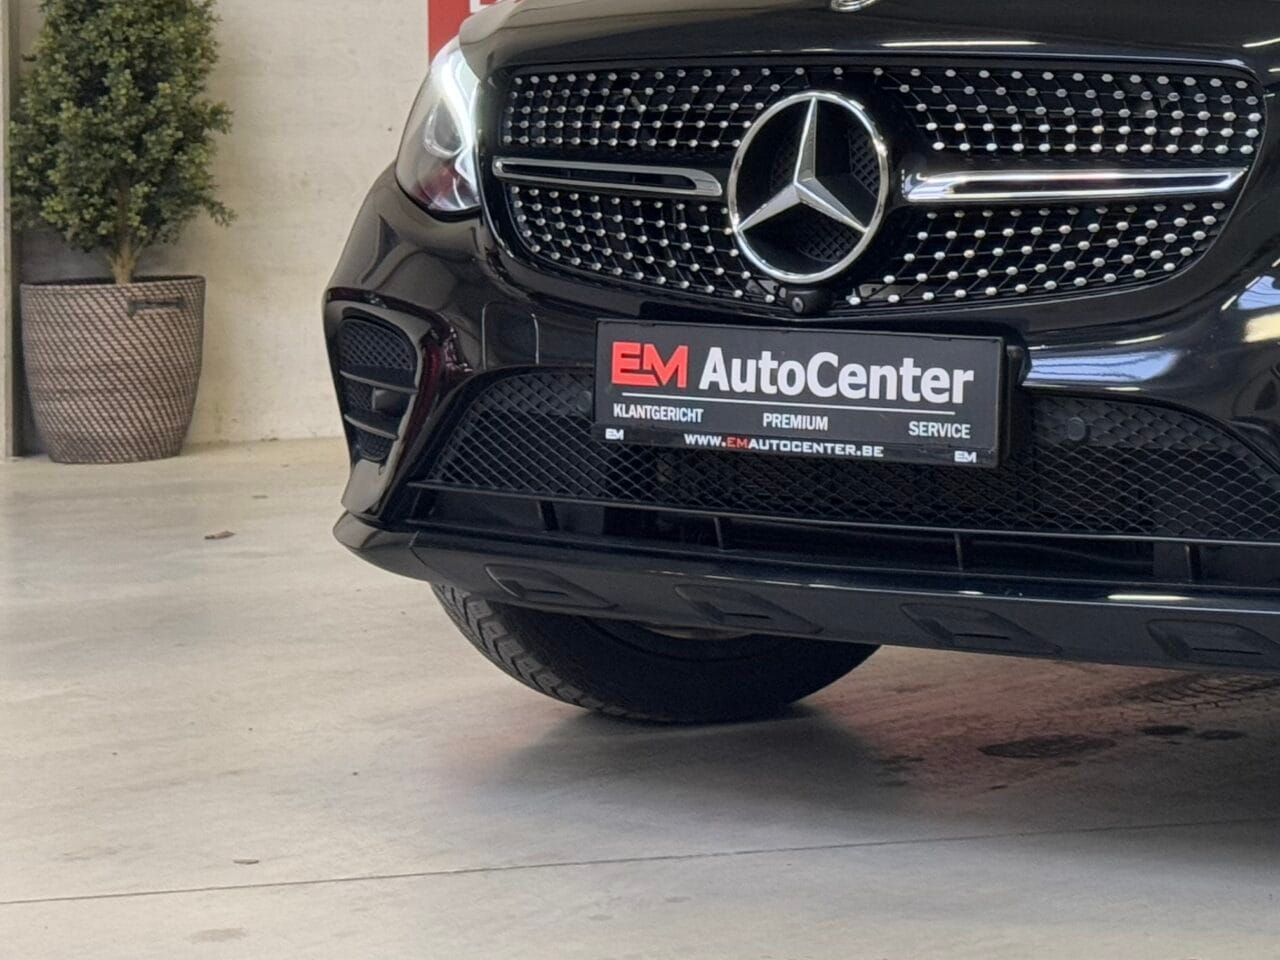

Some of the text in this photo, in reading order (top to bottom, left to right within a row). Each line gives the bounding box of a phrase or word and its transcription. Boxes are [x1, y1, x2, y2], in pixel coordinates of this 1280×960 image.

[611, 341, 975, 404] EM AutoCenter
[613, 403, 971, 439] KLANTGERICHT PREMIUM SERVICE
[605, 428, 977, 463] EM WWW.EMAUTOCENTER.BE EM
